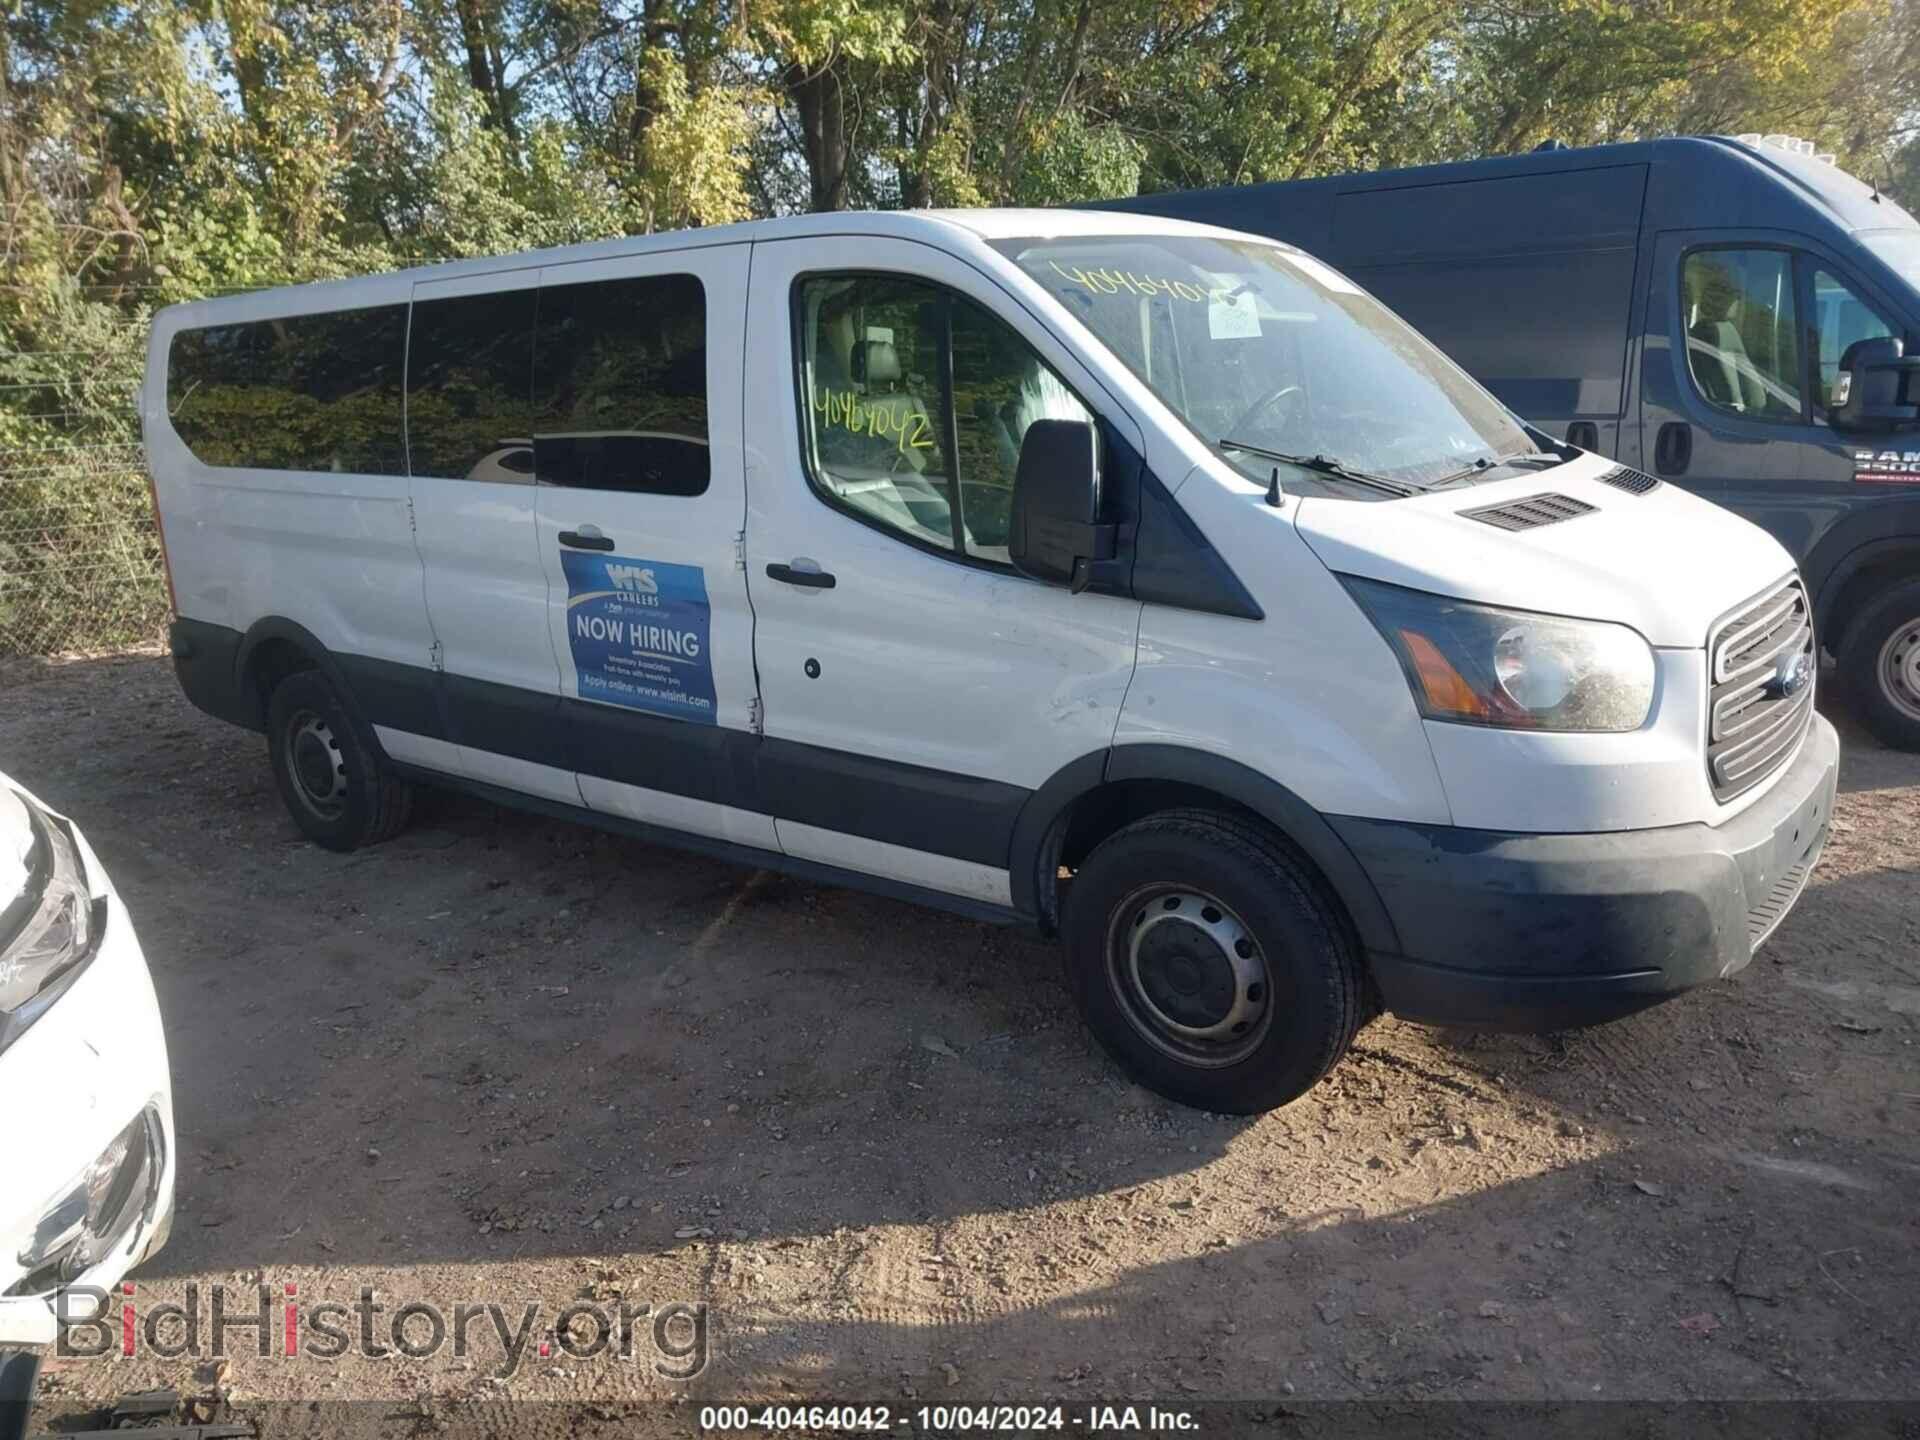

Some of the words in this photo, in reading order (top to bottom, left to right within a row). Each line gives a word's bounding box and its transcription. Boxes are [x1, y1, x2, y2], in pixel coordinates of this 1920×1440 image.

[813, 383, 934, 453] 40464042
[1855, 450, 1920, 462] RAM
[605, 563, 658, 594] WIS
[576, 615, 623, 644] NOW
[630, 623, 700, 657] HIRING
